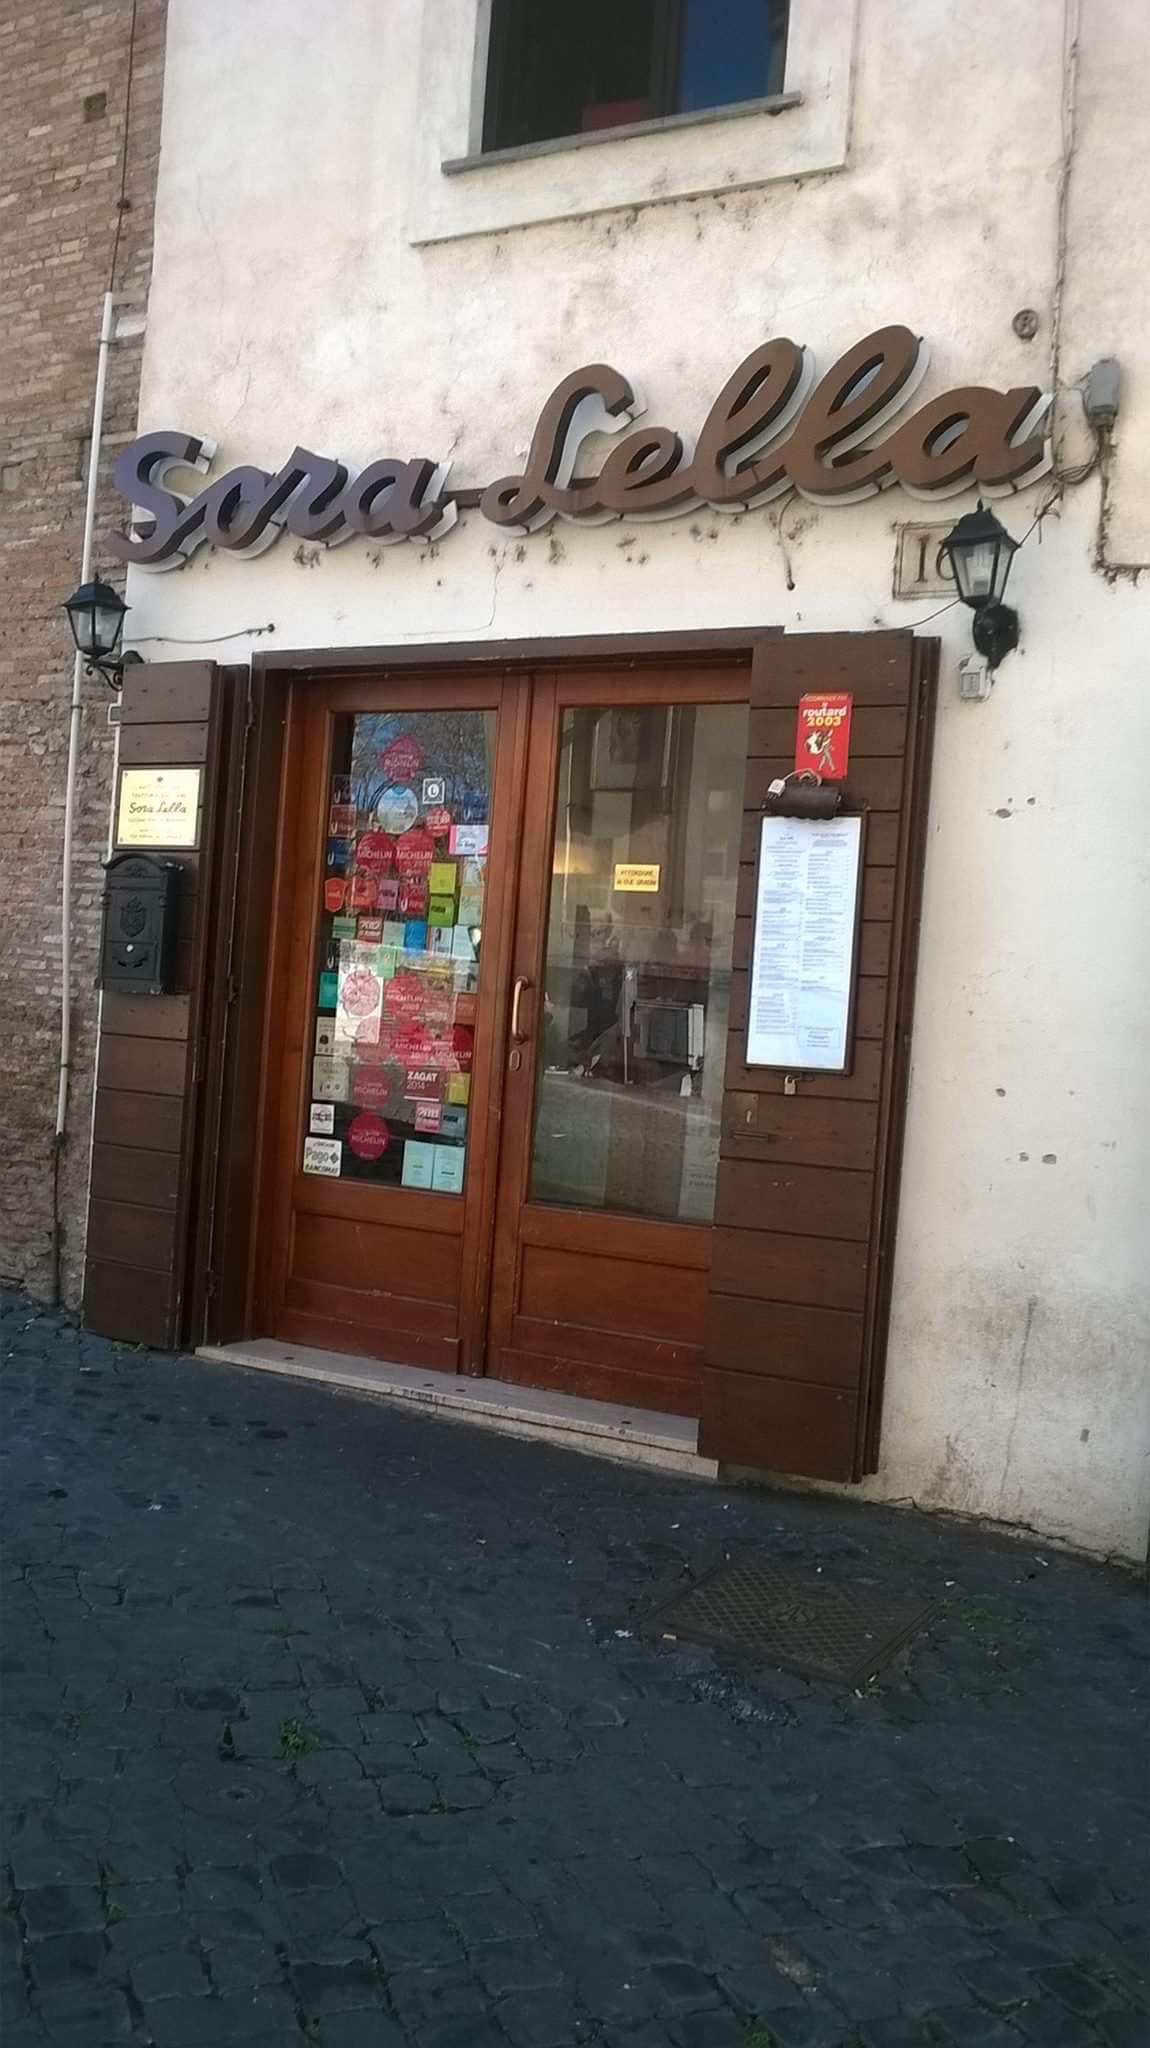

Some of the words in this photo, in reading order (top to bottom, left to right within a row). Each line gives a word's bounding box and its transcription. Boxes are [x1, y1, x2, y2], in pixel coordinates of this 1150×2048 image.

[101, 430, 452, 567] Sora
[480, 324, 1048, 526] Lella
[802, 706, 847, 717] routard
[806, 716, 842, 727] 2003
[129, 801, 154, 814] Sora
[157, 800, 187, 814] Lella
[357, 849, 394, 859] MICHELIN
[396, 849, 434, 860] MICHELIN
[407, 1070, 438, 1083] ZAGAT
[353, 1085, 389, 1097] MICHELIN
[351, 1133, 387, 1146] MICHELIN
[305, 1146, 330, 1164] Pago
